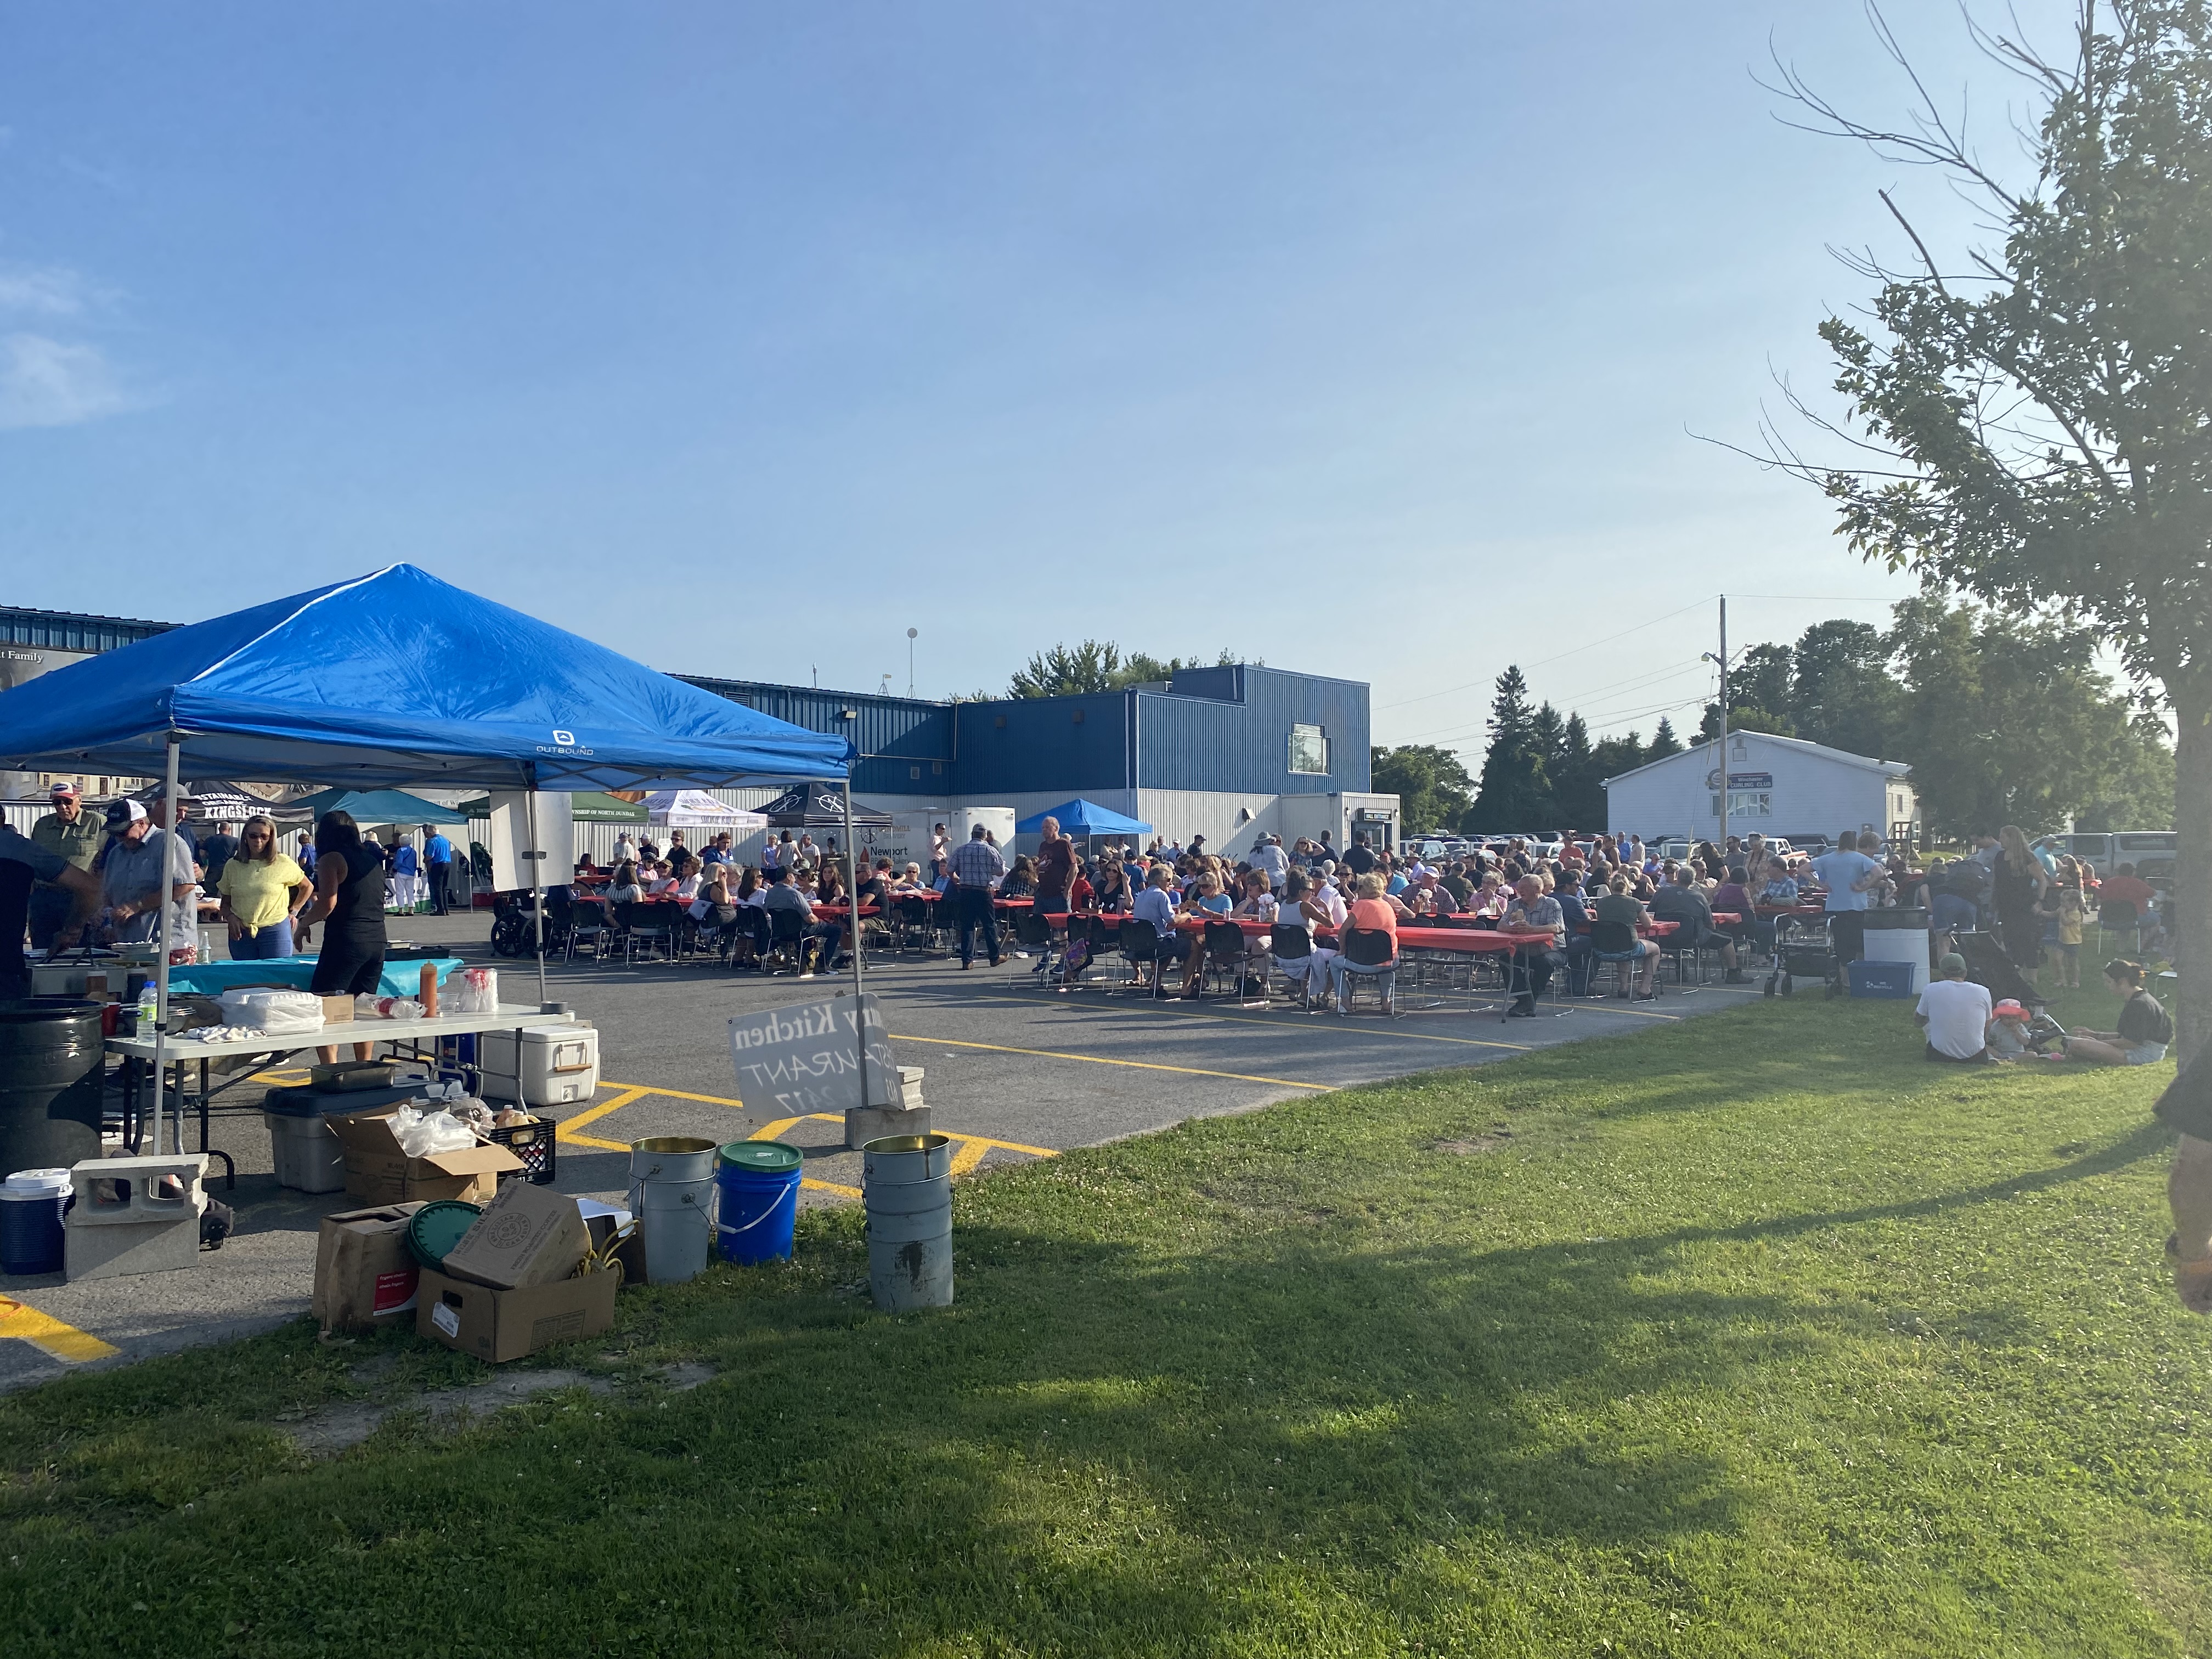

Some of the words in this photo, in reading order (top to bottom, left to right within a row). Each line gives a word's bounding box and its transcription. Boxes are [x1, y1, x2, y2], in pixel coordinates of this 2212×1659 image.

[8, 650, 43, 663] Family
[537, 746, 594, 755] OUTBOUND
[871, 847, 908, 858] Newport
